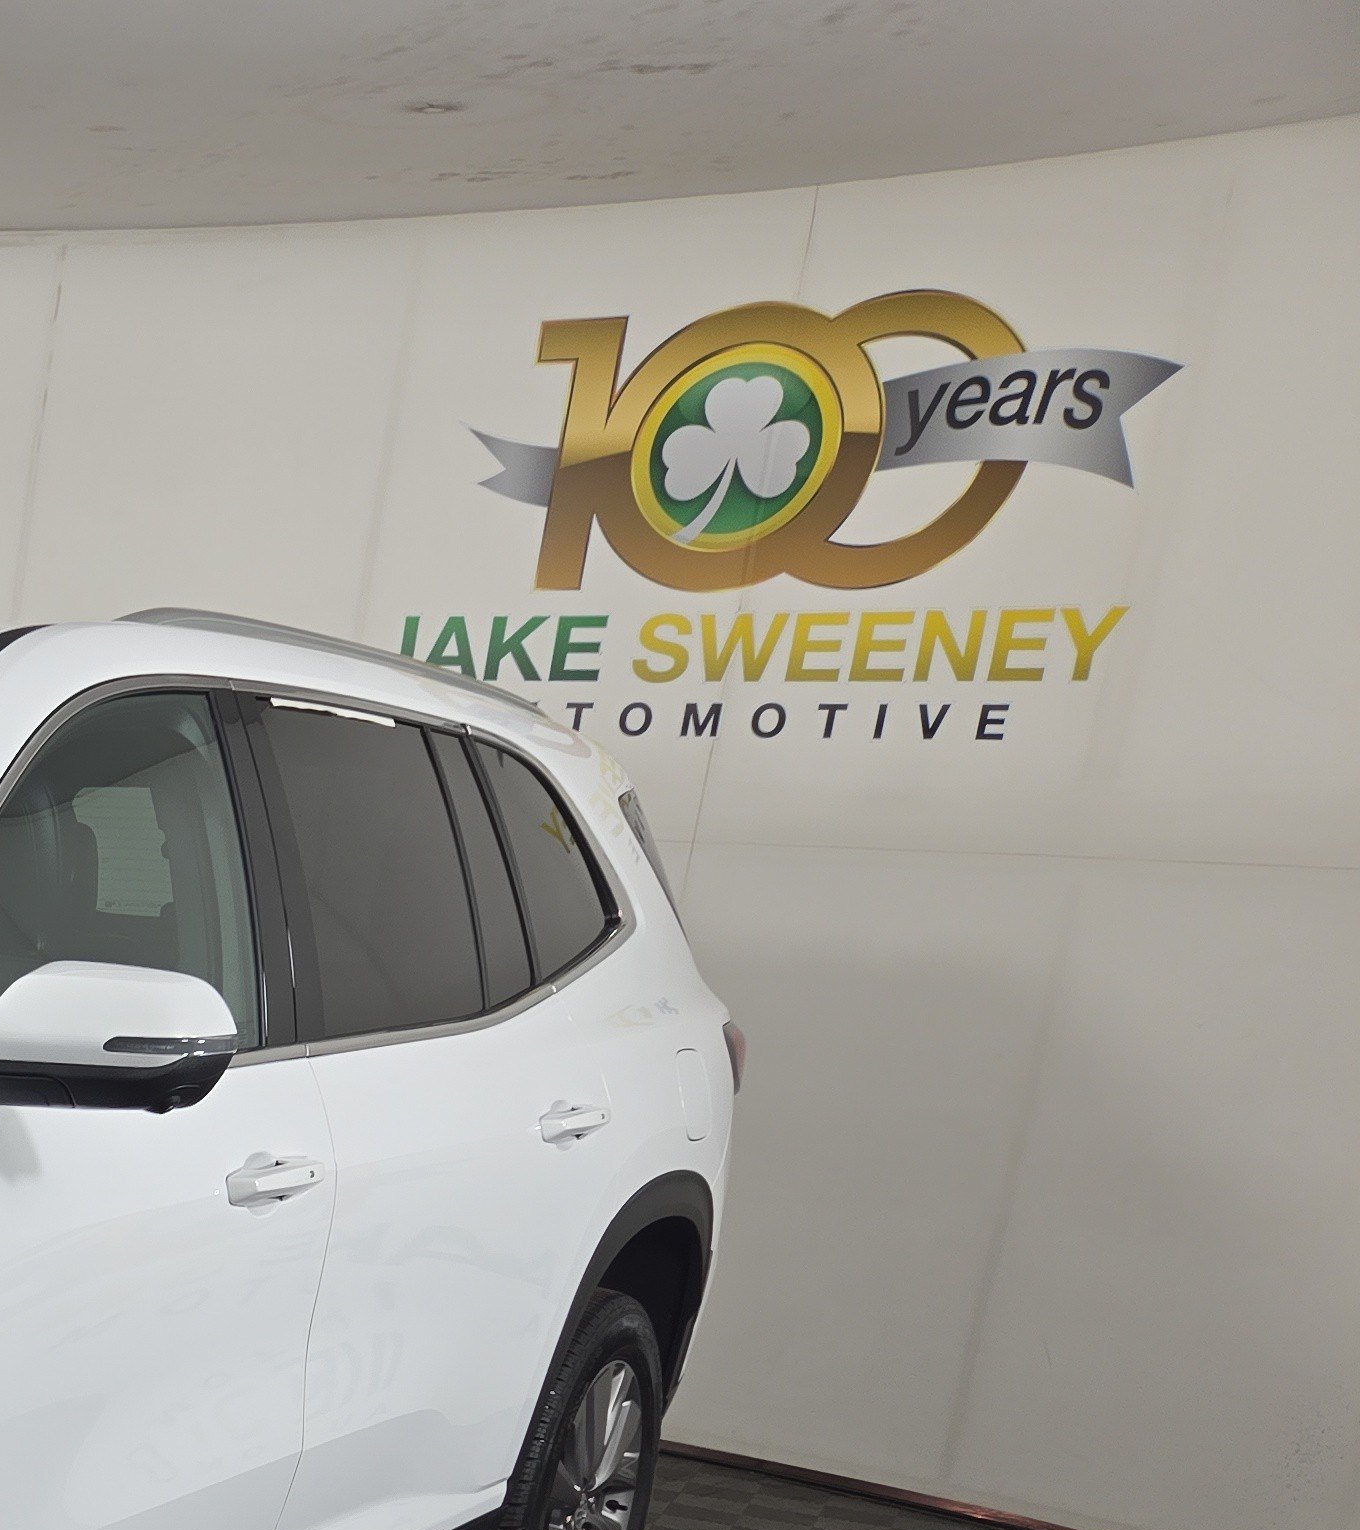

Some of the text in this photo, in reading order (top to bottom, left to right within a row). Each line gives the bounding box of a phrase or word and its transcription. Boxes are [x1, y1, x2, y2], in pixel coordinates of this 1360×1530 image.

[534, 288, 1029, 593] 100
[895, 365, 1112, 456] years
[632, 606, 1130, 684] SWEENEY
[564, 701, 1011, 741] TOMOTIVE
